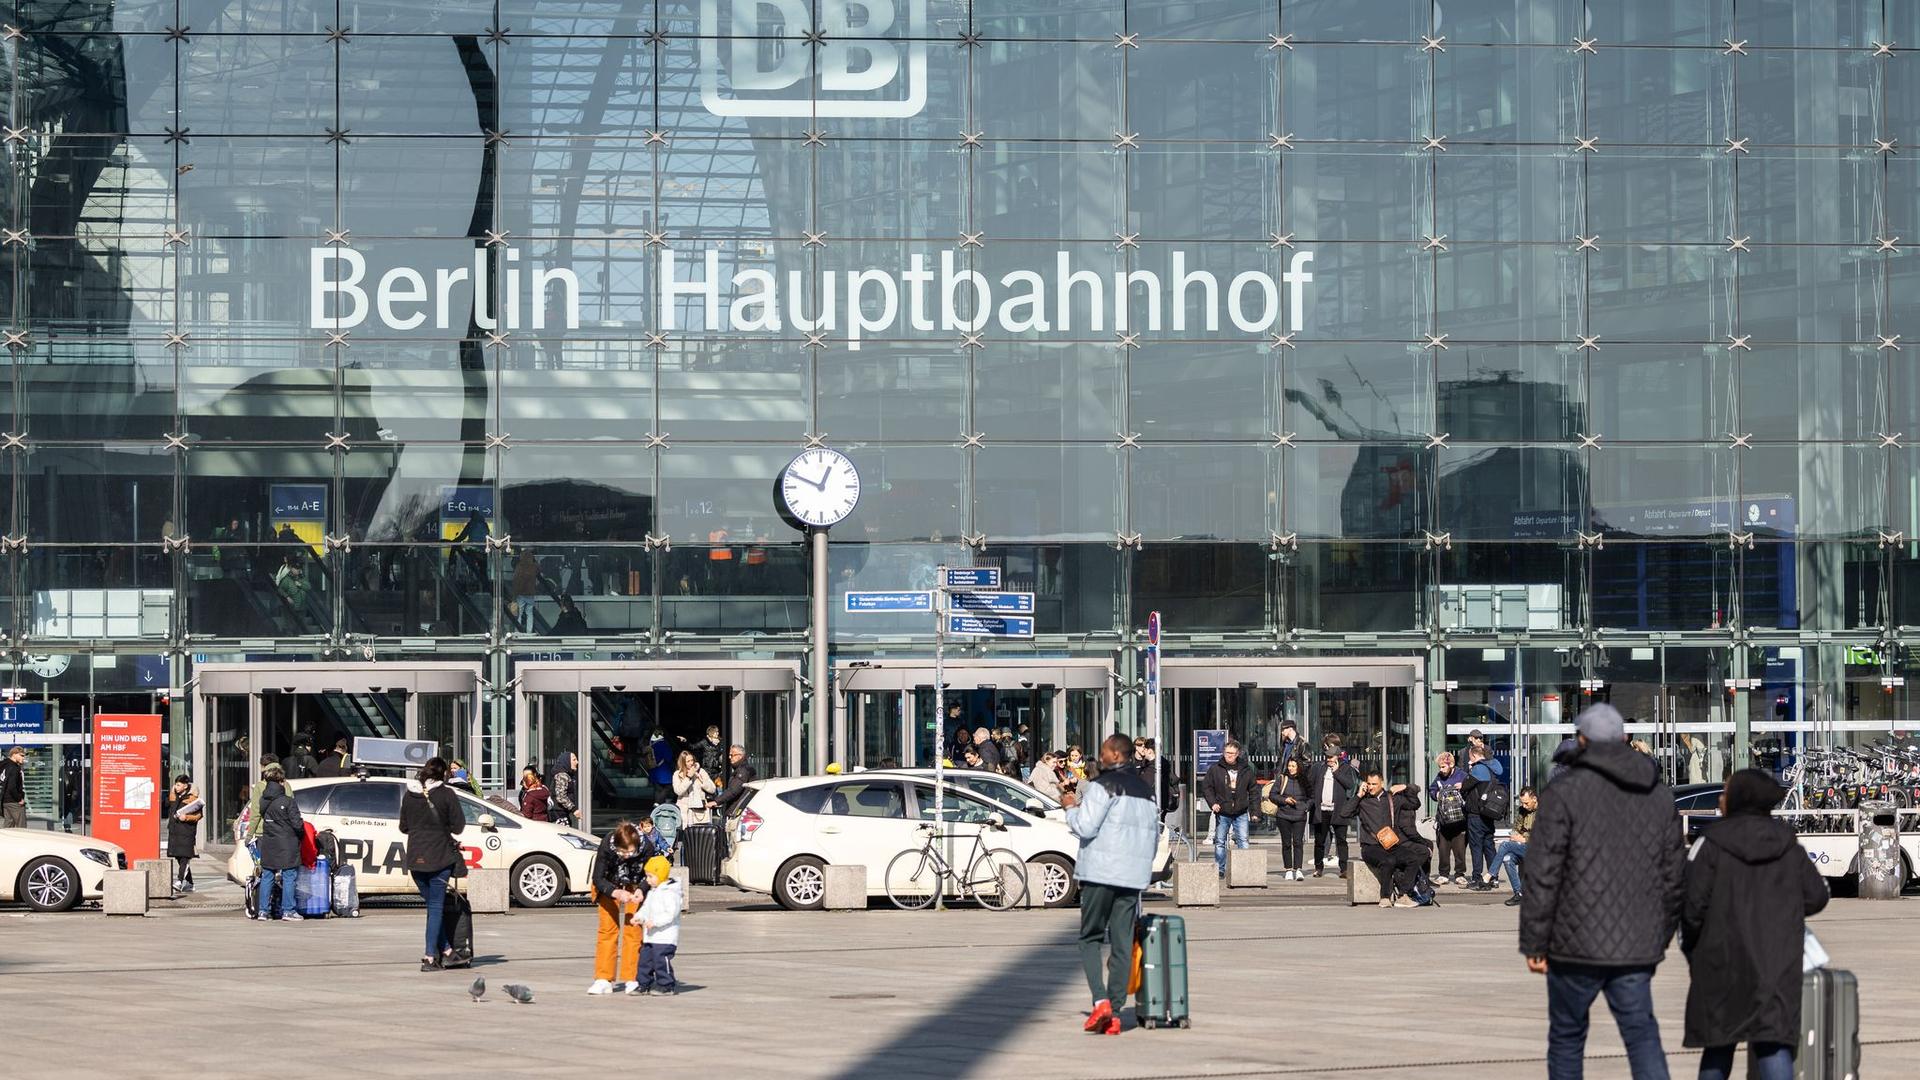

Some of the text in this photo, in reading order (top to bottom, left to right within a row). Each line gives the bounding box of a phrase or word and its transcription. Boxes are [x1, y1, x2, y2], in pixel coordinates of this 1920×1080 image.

[732, 0, 899, 90] DB
[310, 247, 1314, 352] Berlin Hauptbahnhof
[301, 501, 320, 511] A-E
[447, 501, 466, 512] E-G
[100, 734, 113, 742] HIN
[130, 735, 148, 743] WEG
[113, 744, 127, 752] HBF
[350, 819, 387, 827] plan-b.taxi
